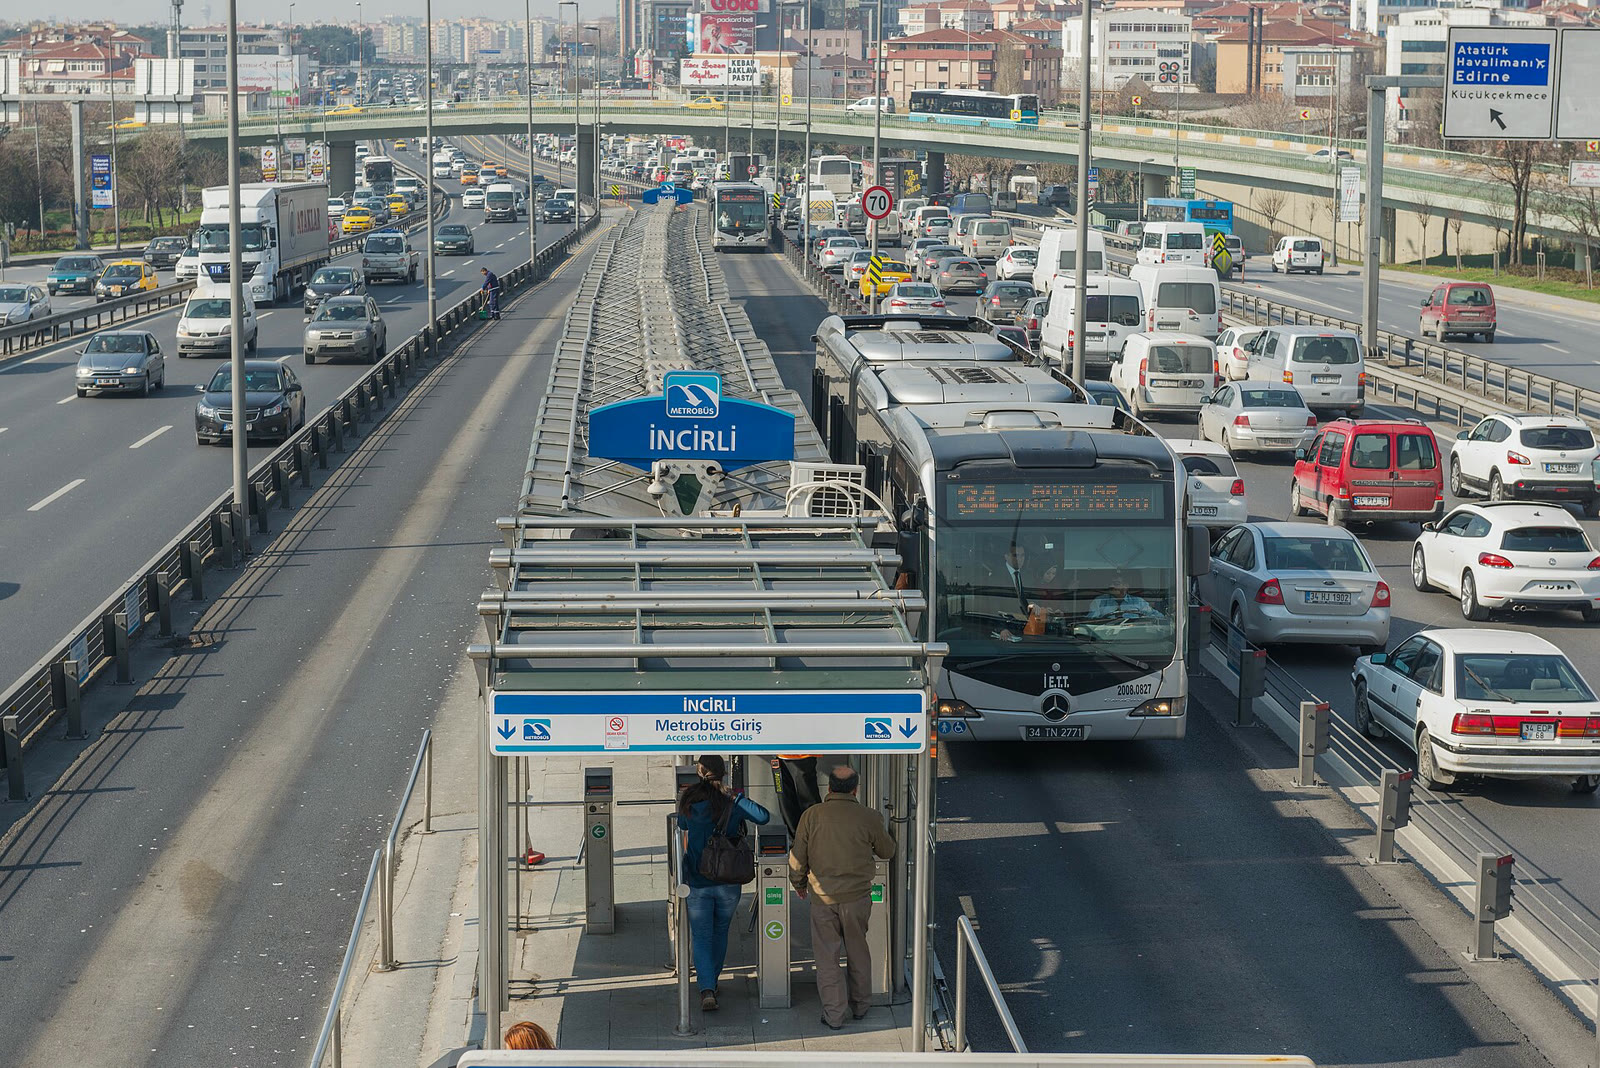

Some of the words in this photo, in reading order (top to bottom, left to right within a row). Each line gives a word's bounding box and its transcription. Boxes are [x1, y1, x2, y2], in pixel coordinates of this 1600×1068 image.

[1457, 45, 1509, 55] Atatürk
[1456, 57, 1533, 68] Havalimanı
[1456, 70, 1511, 82] Edirne
[1451, 90, 1548, 101] Küçükçekmece
[869, 195, 886, 211] 70
[211, 266, 222, 274] TIR
[670, 406, 714, 415] METROBÜS
[650, 424, 736, 452] İNCİRLİ
[1310, 592, 1319, 601] 34
[1322, 593, 1330, 601] HJ
[1333, 593, 1349, 602] 1902
[1117, 683, 1152, 696] 2008.0827
[683, 697, 736, 712] İNCİRLİ
[655, 718, 725, 732] Metrobüs
[730, 718, 762, 734] Giriş
[1525, 724, 1534, 732] 34
[665, 734, 695, 742] Access
[697, 734, 708, 742] to
[709, 732, 753, 741] Metrobus
[1028, 728, 1041, 737] 34
[1045, 728, 1059, 737] TN
[1060, 728, 1082, 737] 2771
